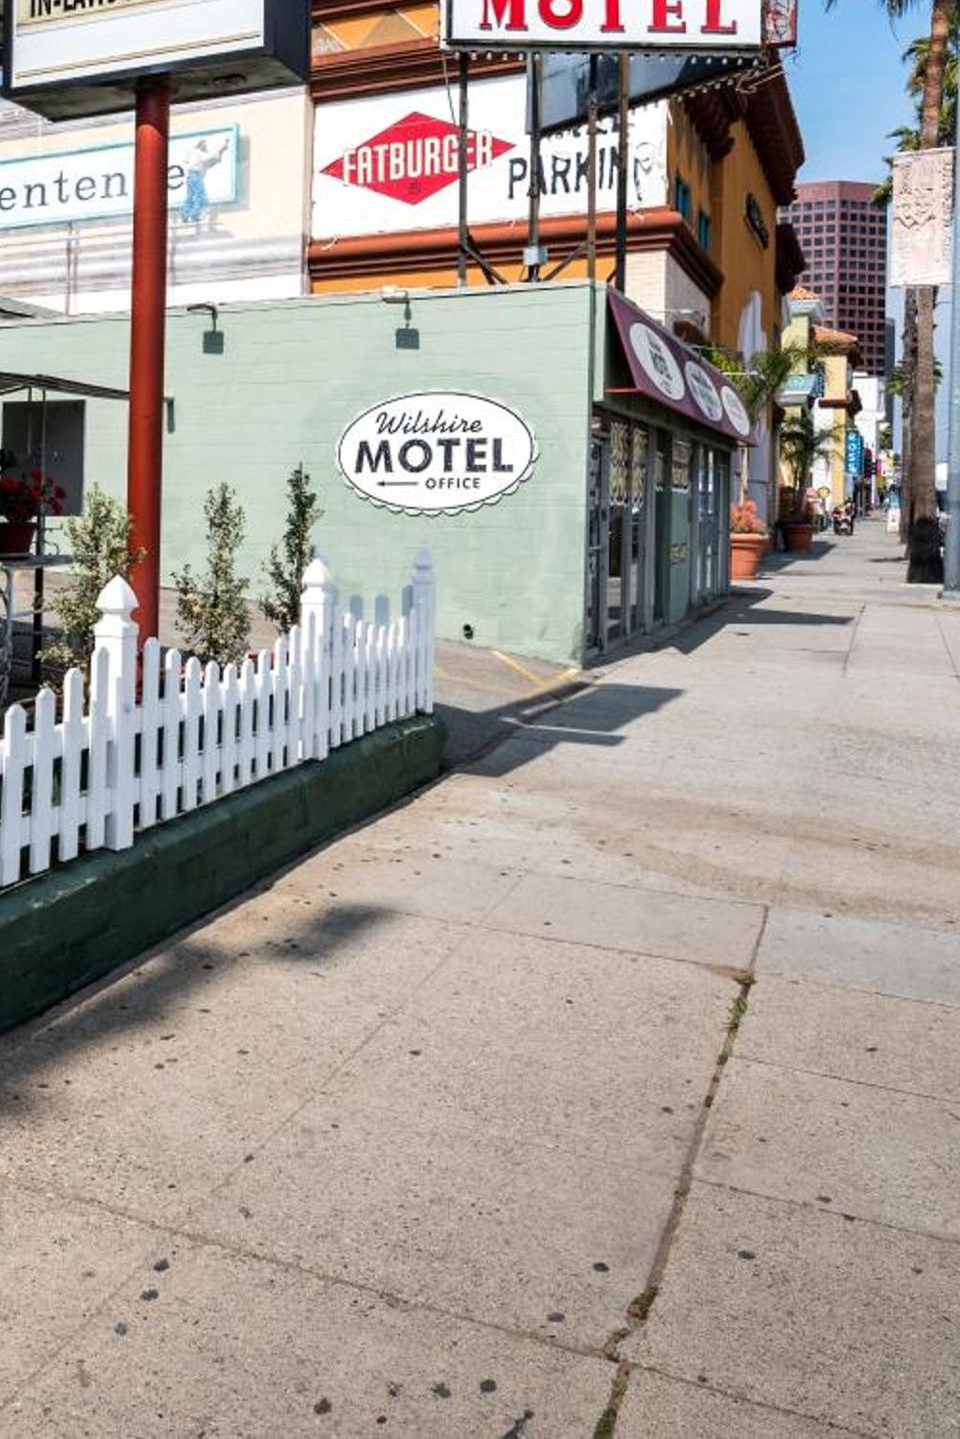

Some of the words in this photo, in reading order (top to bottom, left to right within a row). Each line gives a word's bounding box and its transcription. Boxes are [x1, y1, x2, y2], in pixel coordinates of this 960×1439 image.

[375, 409, 483, 434] Wilshire
[354, 438, 514, 474] MOTEL
[425, 478, 481, 490] OFFICE
